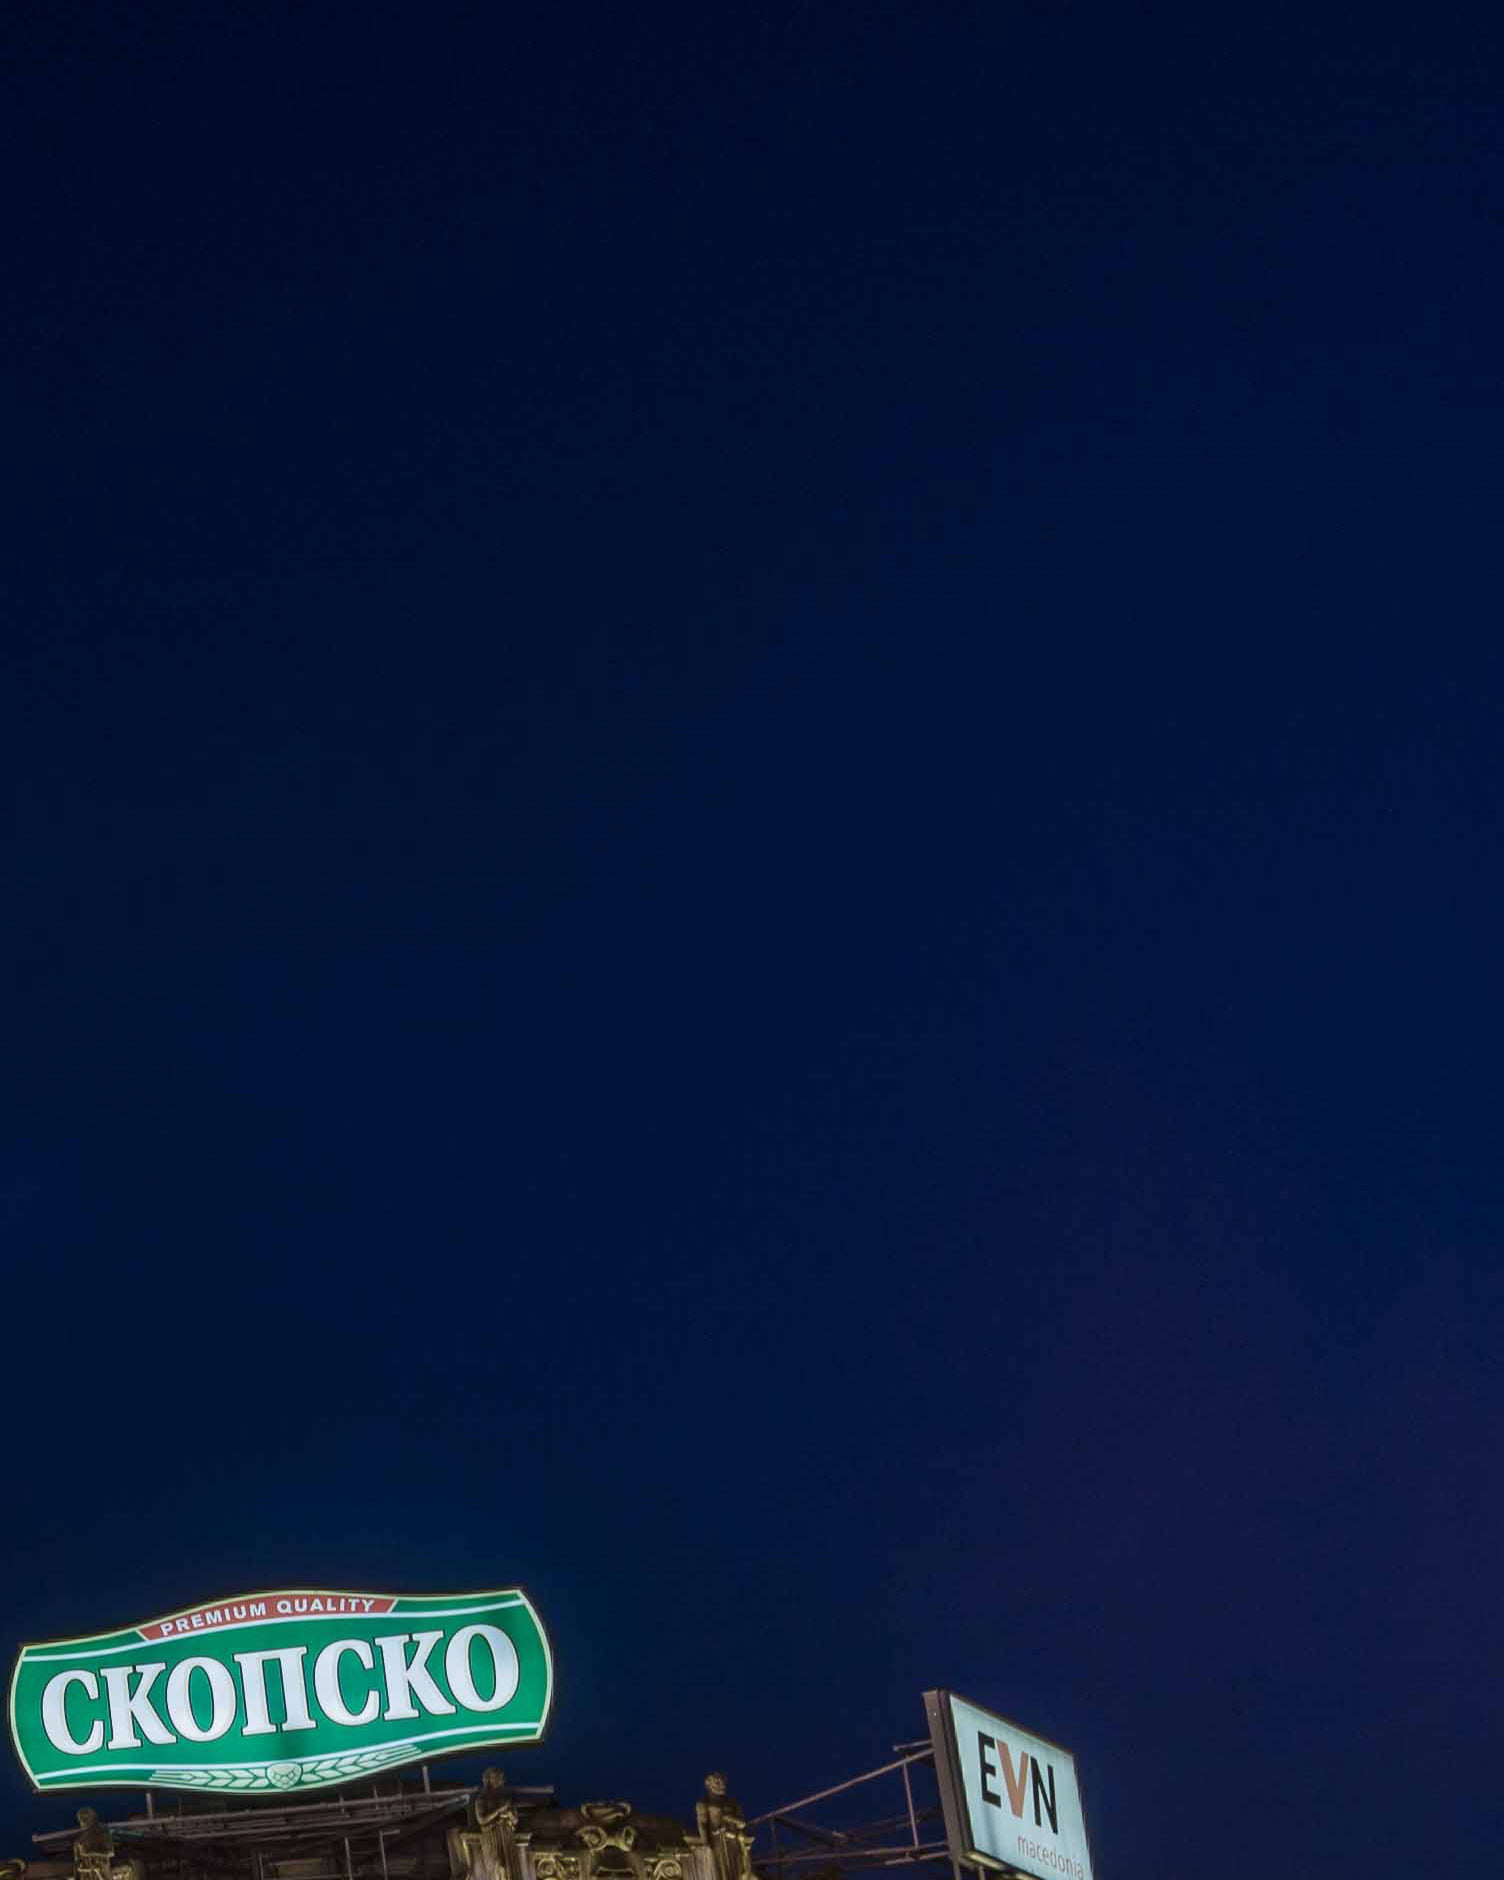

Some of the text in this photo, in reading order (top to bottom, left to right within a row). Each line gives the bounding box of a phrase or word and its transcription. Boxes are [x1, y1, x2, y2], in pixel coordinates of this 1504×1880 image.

[160, 1598, 375, 1636] PREMIUM QUALITY
[42, 1625, 520, 1756] СКОПСКО
[977, 1730, 1058, 1835] EVN
[1017, 1835, 1085, 1880] macedonia
